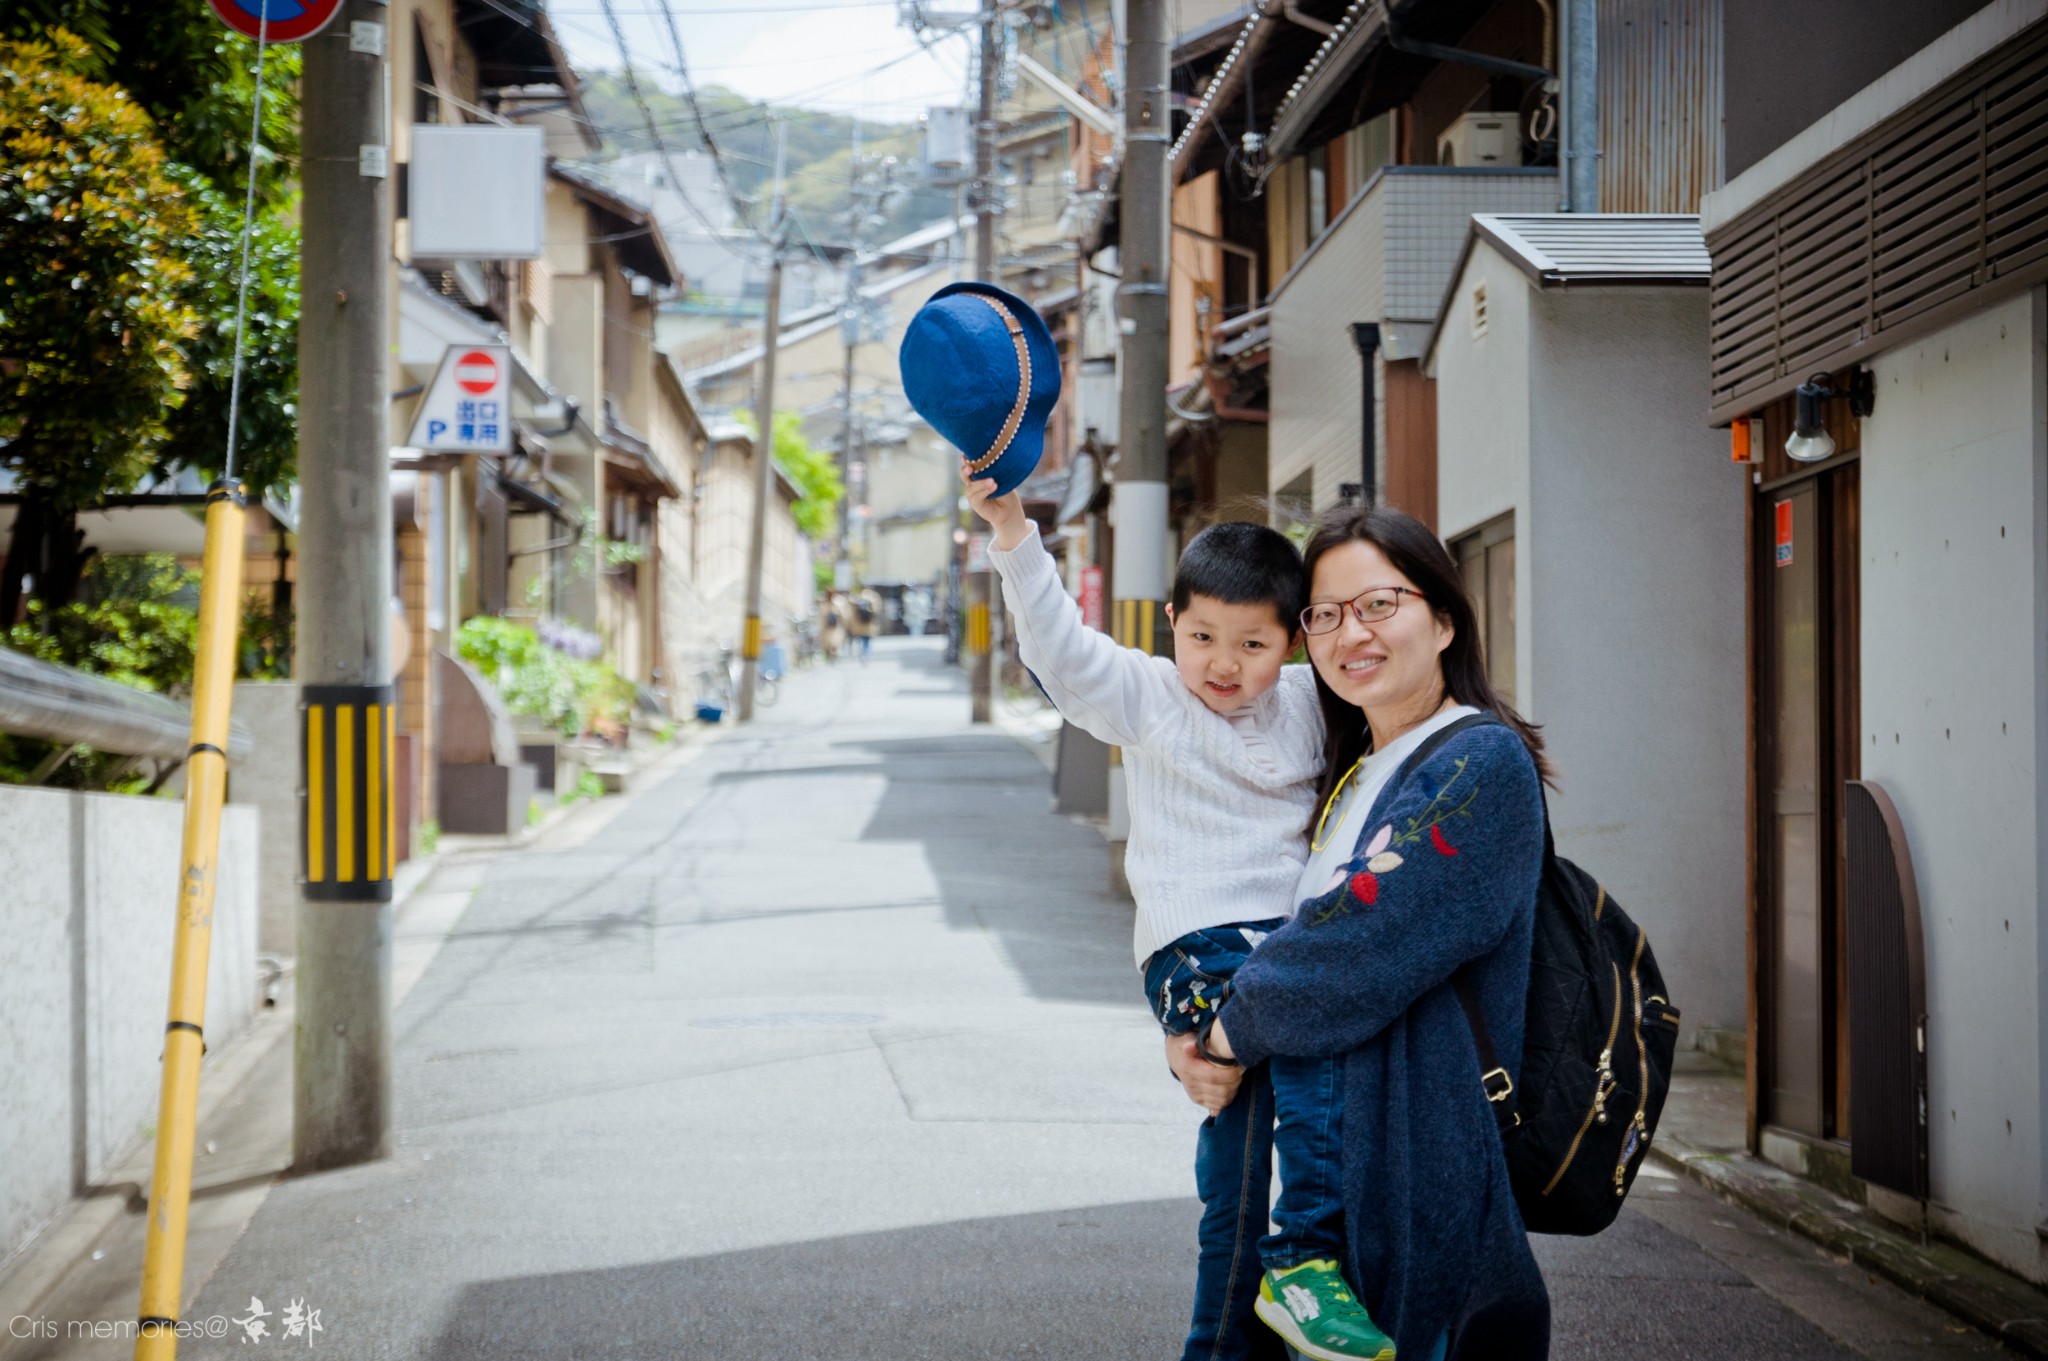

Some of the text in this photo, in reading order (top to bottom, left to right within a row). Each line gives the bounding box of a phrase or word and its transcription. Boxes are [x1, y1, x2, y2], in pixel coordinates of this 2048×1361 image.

[456, 401, 498, 420] 出口
[428, 421, 447, 442] P
[457, 424, 498, 442] 専用
